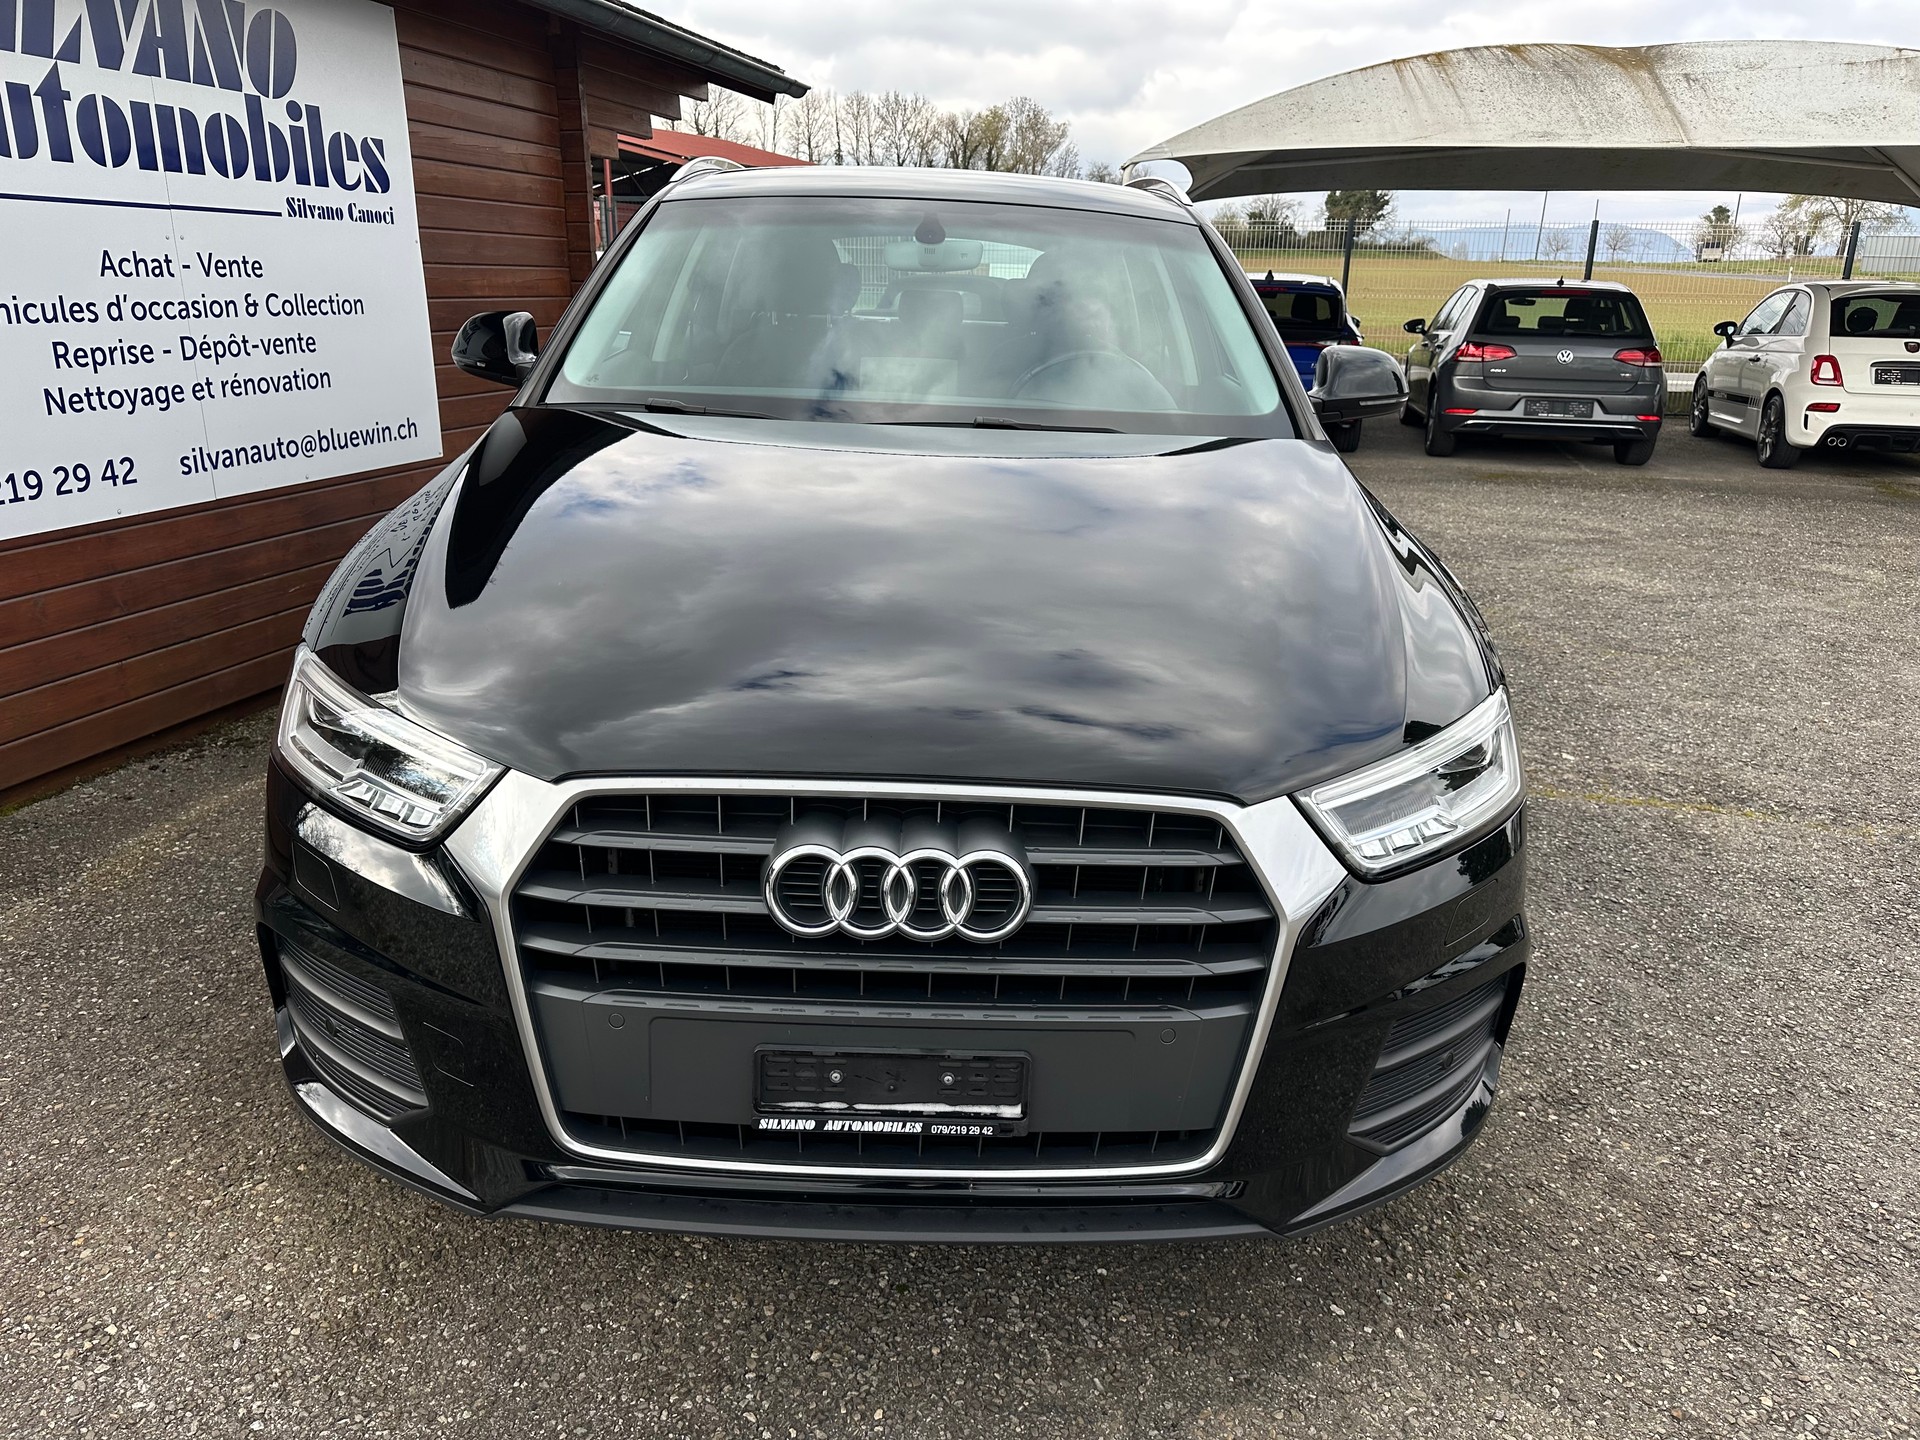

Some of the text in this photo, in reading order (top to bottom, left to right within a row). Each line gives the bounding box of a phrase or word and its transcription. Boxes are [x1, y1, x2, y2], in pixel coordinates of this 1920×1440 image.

[0, 0, 297, 99] LVANO
[286, 197, 395, 225] Silvano Canoci
[100, 249, 176, 278] Achat
[196, 251, 264, 279] Vente
[106, 293, 239, 322] d'occasion
[244, 292, 259, 318] &
[265, 292, 365, 317] Collection
[51, 338, 155, 375] Reprise
[179, 332, 317, 366] Dépôt-vente
[43, 370, 332, 416] Nettoyage et rénovation
[179, 417, 419, 476] silvanauto@bluewin.ch
[0, 456, 138, 505] 19 29 42
[758, 1118, 994, 1136] SILVANO AUTOMOBILES 079/219 29 42
